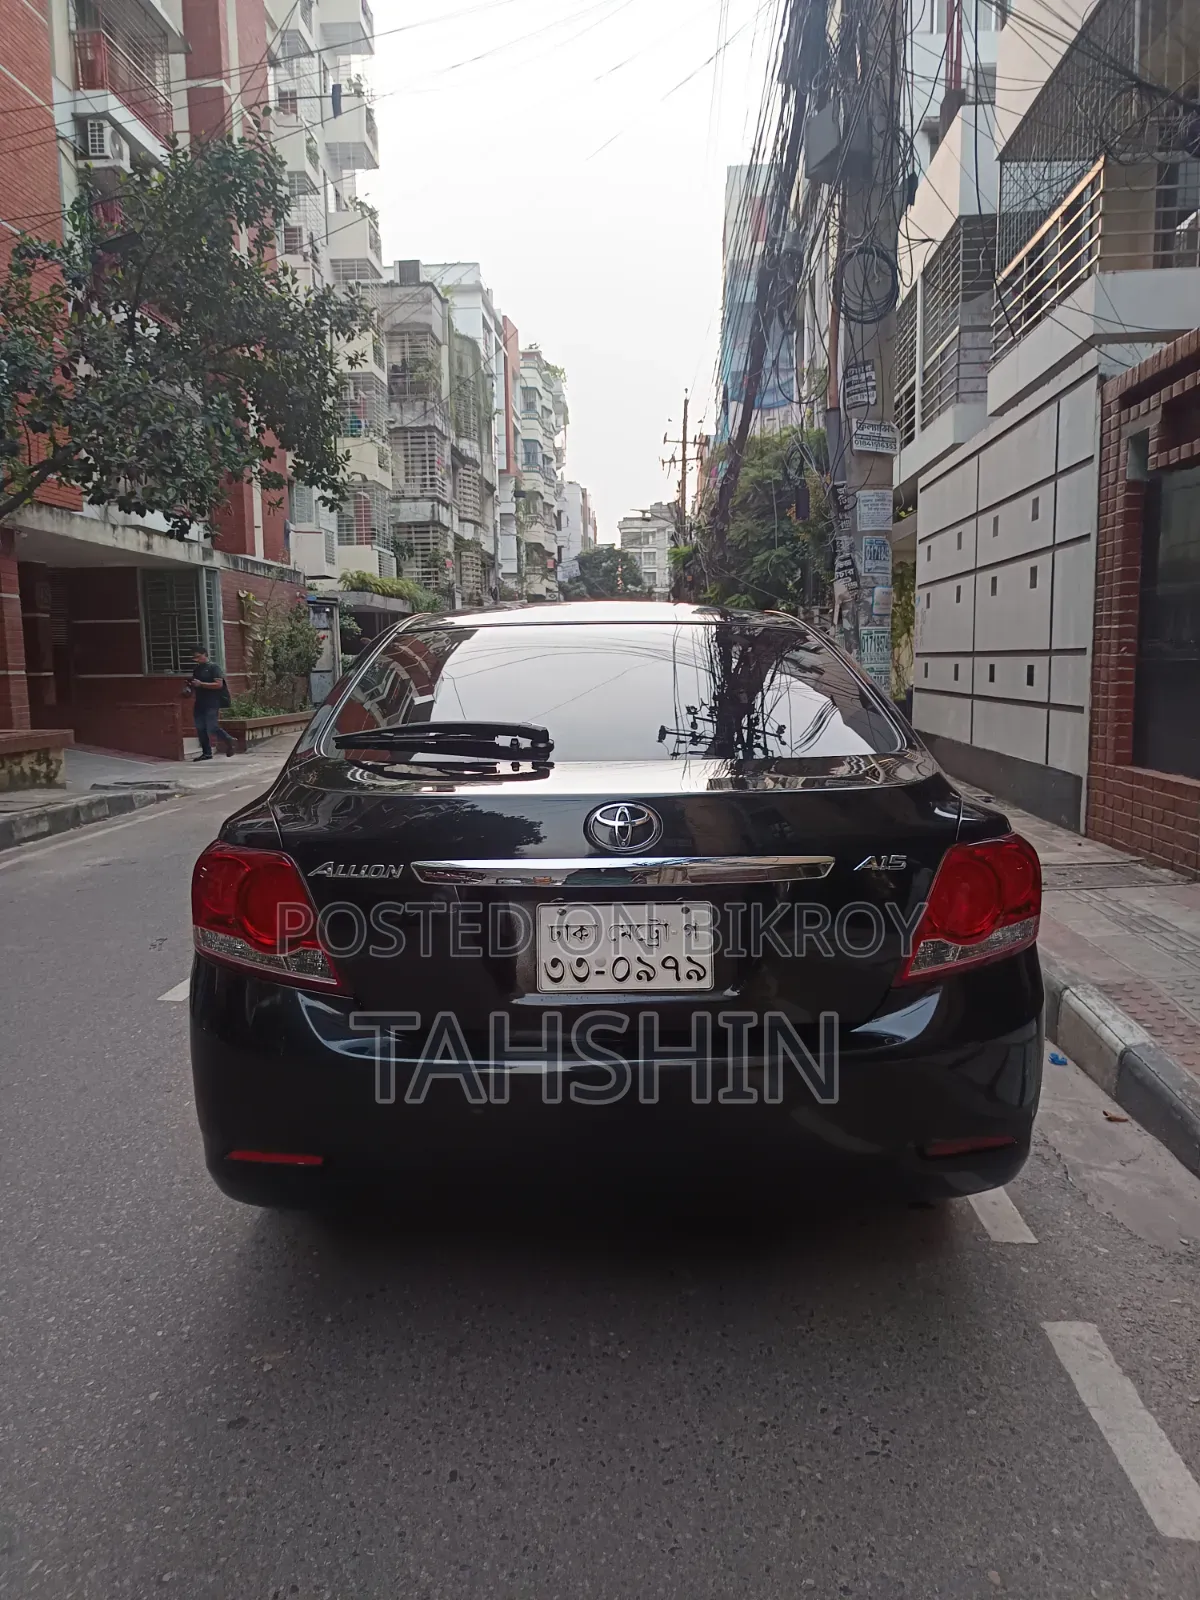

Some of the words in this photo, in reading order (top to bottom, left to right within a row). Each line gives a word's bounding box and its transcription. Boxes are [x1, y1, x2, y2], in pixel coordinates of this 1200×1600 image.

[307, 861, 404, 879] ALLION
[853, 854, 907, 871] A15
[548, 923, 598, 942] ঢাকা
[544, 955, 707, 983] ৩৩-০৯৭৯
